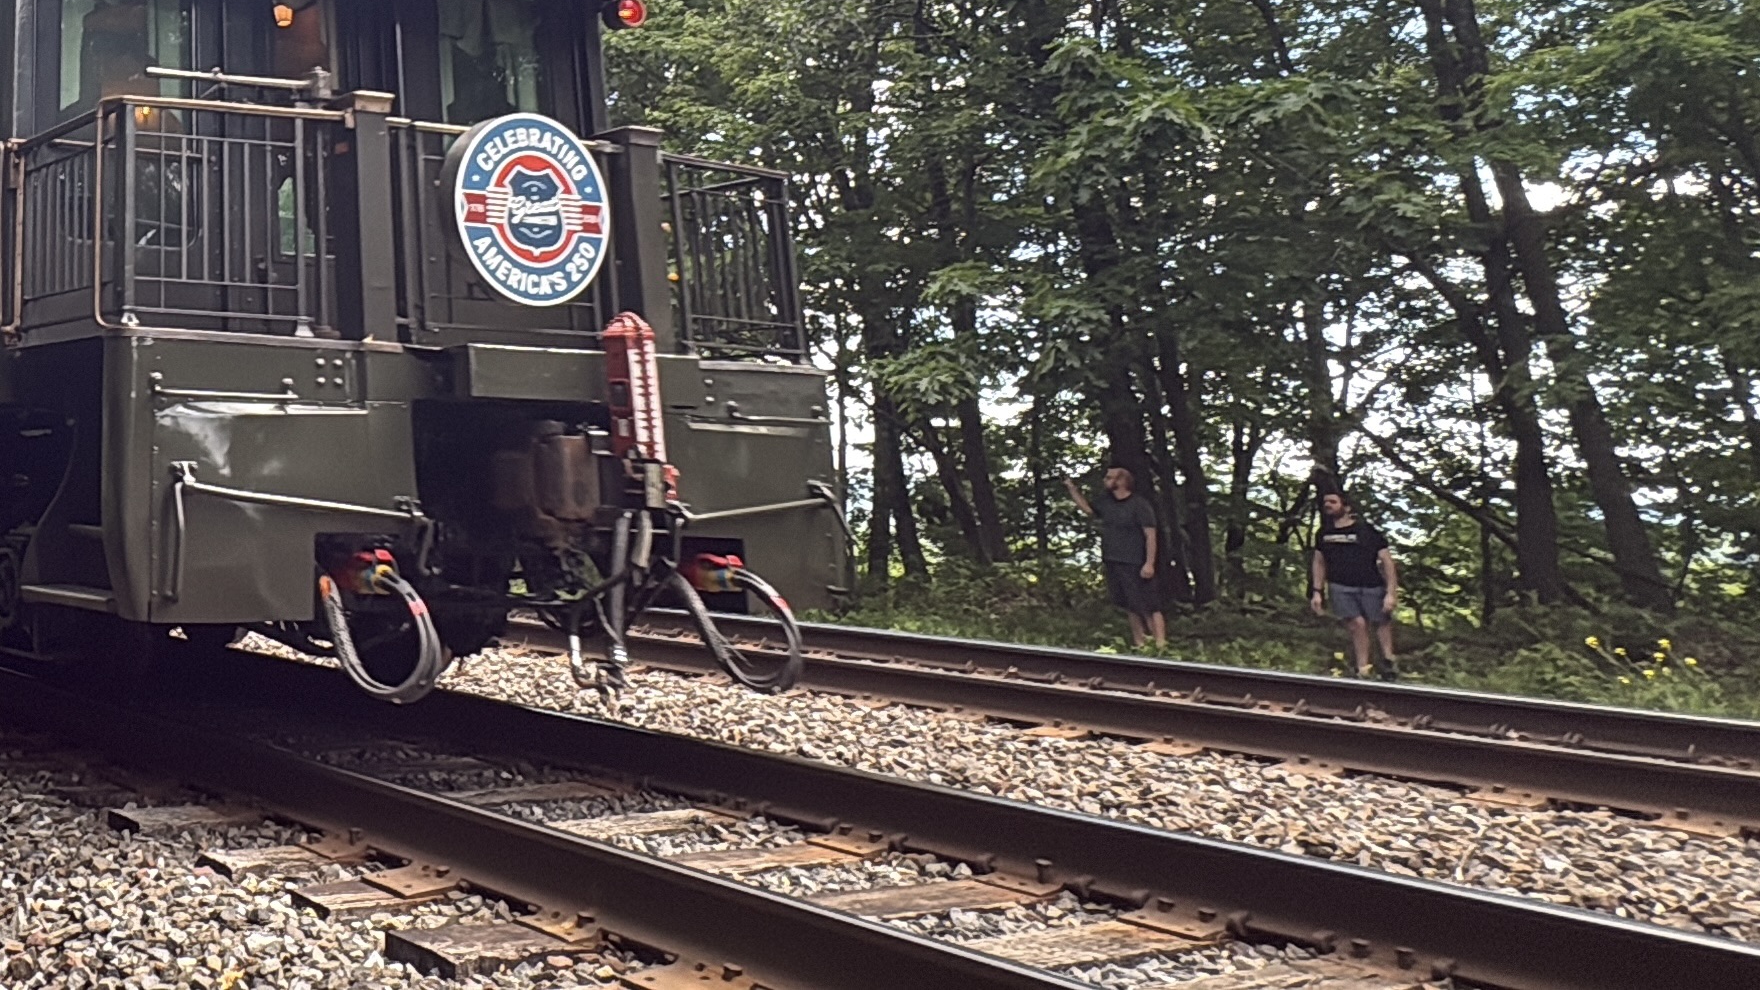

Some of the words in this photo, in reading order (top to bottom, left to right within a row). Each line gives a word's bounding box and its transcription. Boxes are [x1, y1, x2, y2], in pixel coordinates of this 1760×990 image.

[476, 128, 588, 181] CELEBRATING
[473, 237, 568, 295] AMERICA'S
[565, 242, 596, 282] 250
